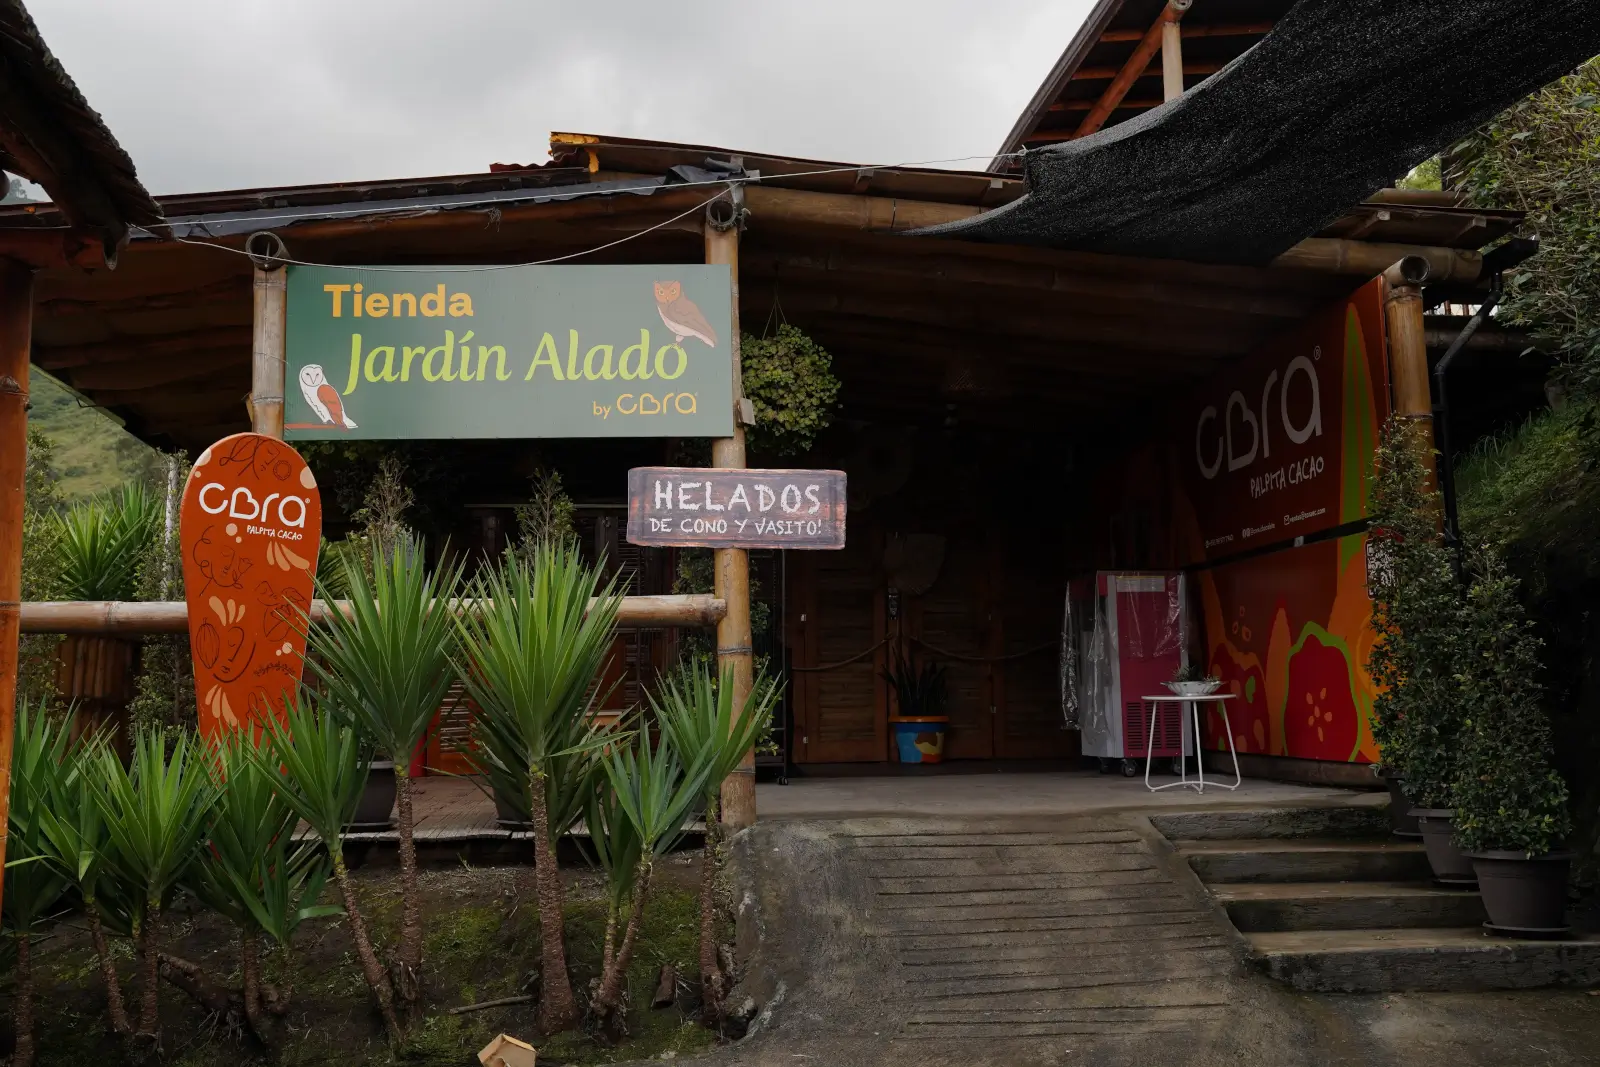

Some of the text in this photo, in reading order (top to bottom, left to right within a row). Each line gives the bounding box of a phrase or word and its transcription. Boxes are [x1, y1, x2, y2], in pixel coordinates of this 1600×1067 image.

[323, 283, 474, 318] Tienda
[342, 328, 688, 396] Jardín Alado
[593, 400, 611, 420] by
[1250, 455, 1325, 499] PALPITA CACAO
[654, 479, 821, 515] HELADOS
[247, 525, 302, 540] PALPITA CACAO
[649, 517, 823, 536] DE CONO Y VASITO!
